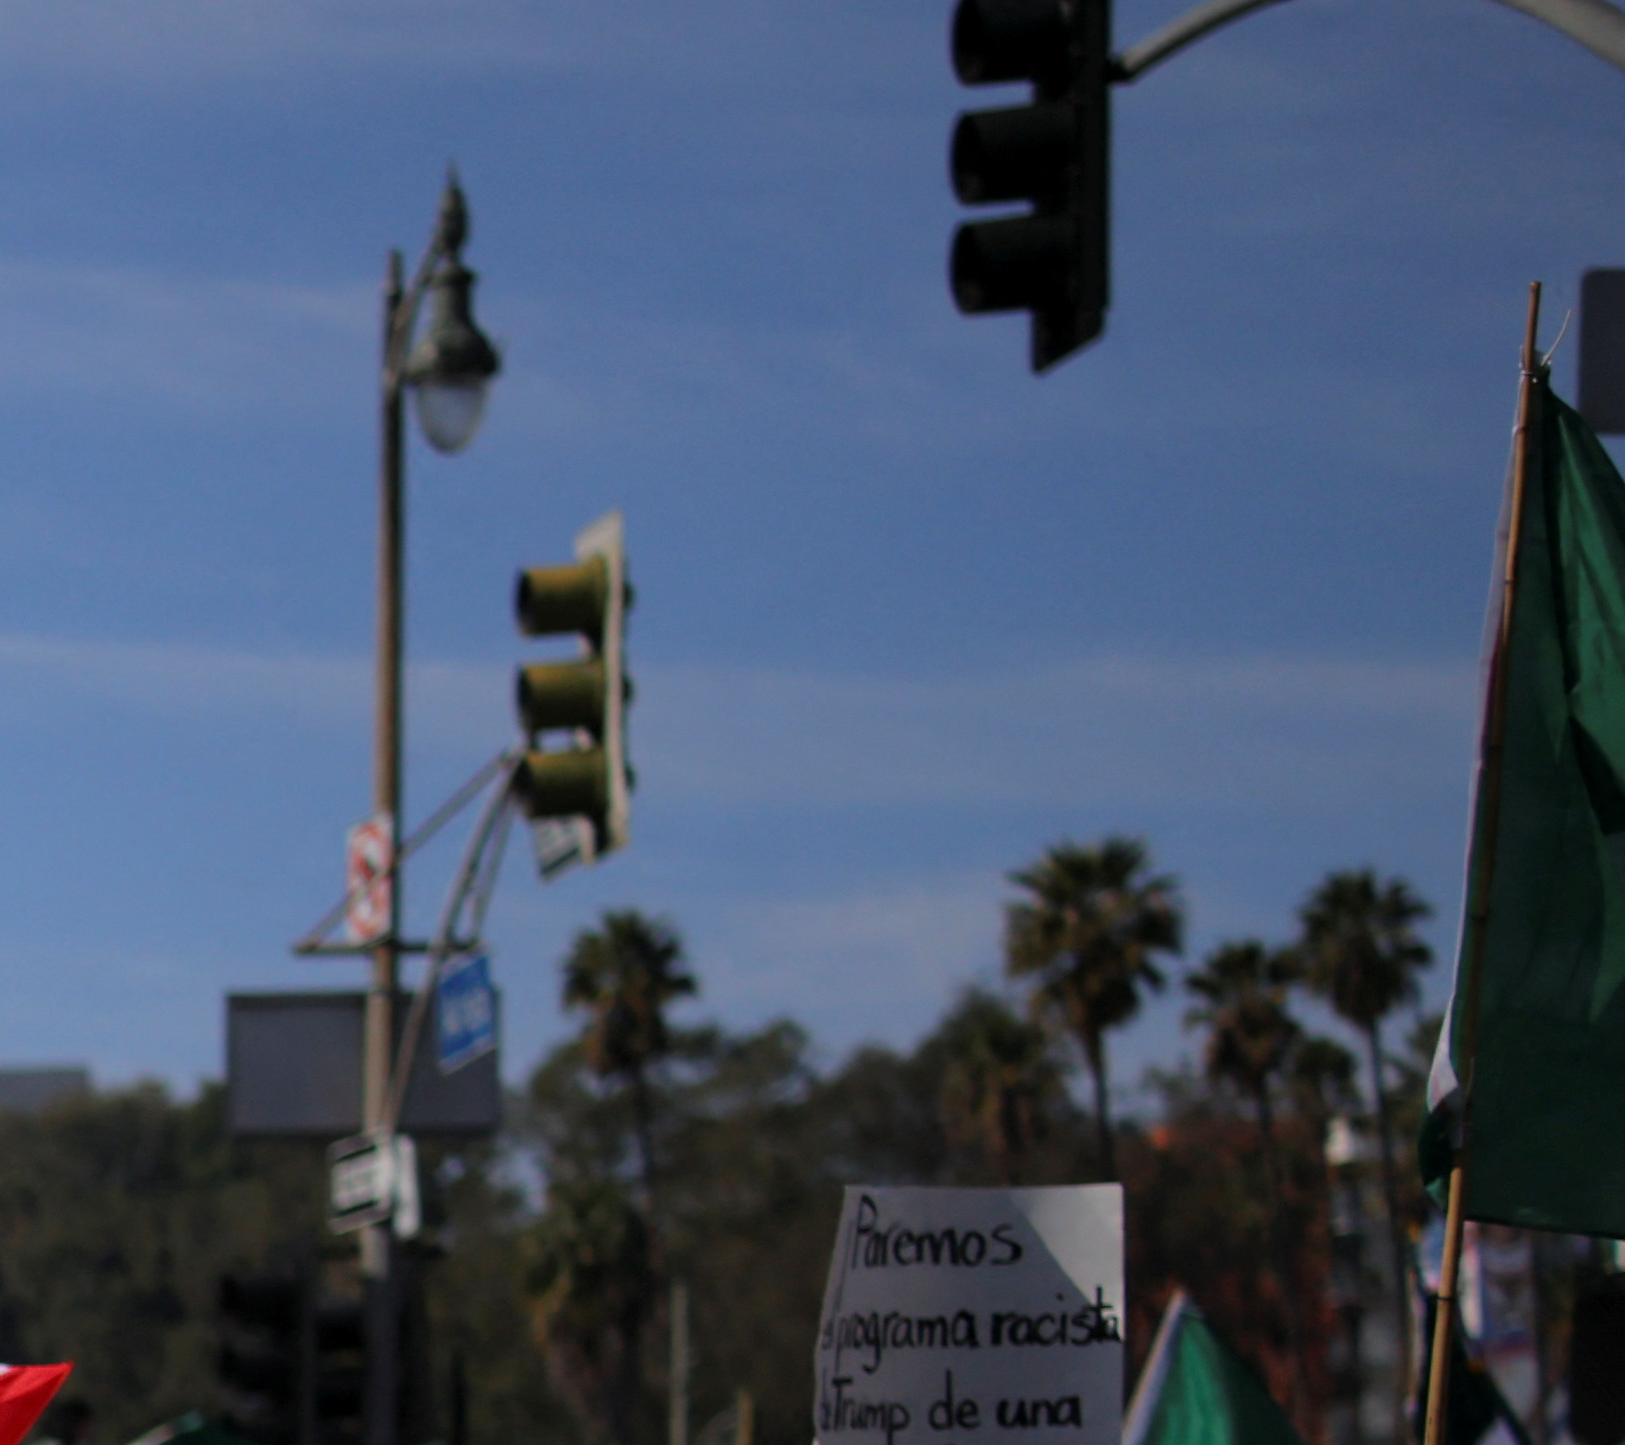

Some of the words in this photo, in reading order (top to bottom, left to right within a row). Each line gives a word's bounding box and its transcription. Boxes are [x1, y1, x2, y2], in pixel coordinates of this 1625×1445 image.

[991, 1285, 1124, 1345] racista
[929, 1369, 980, 1430] de
[997, 1395, 1082, 1428] una
